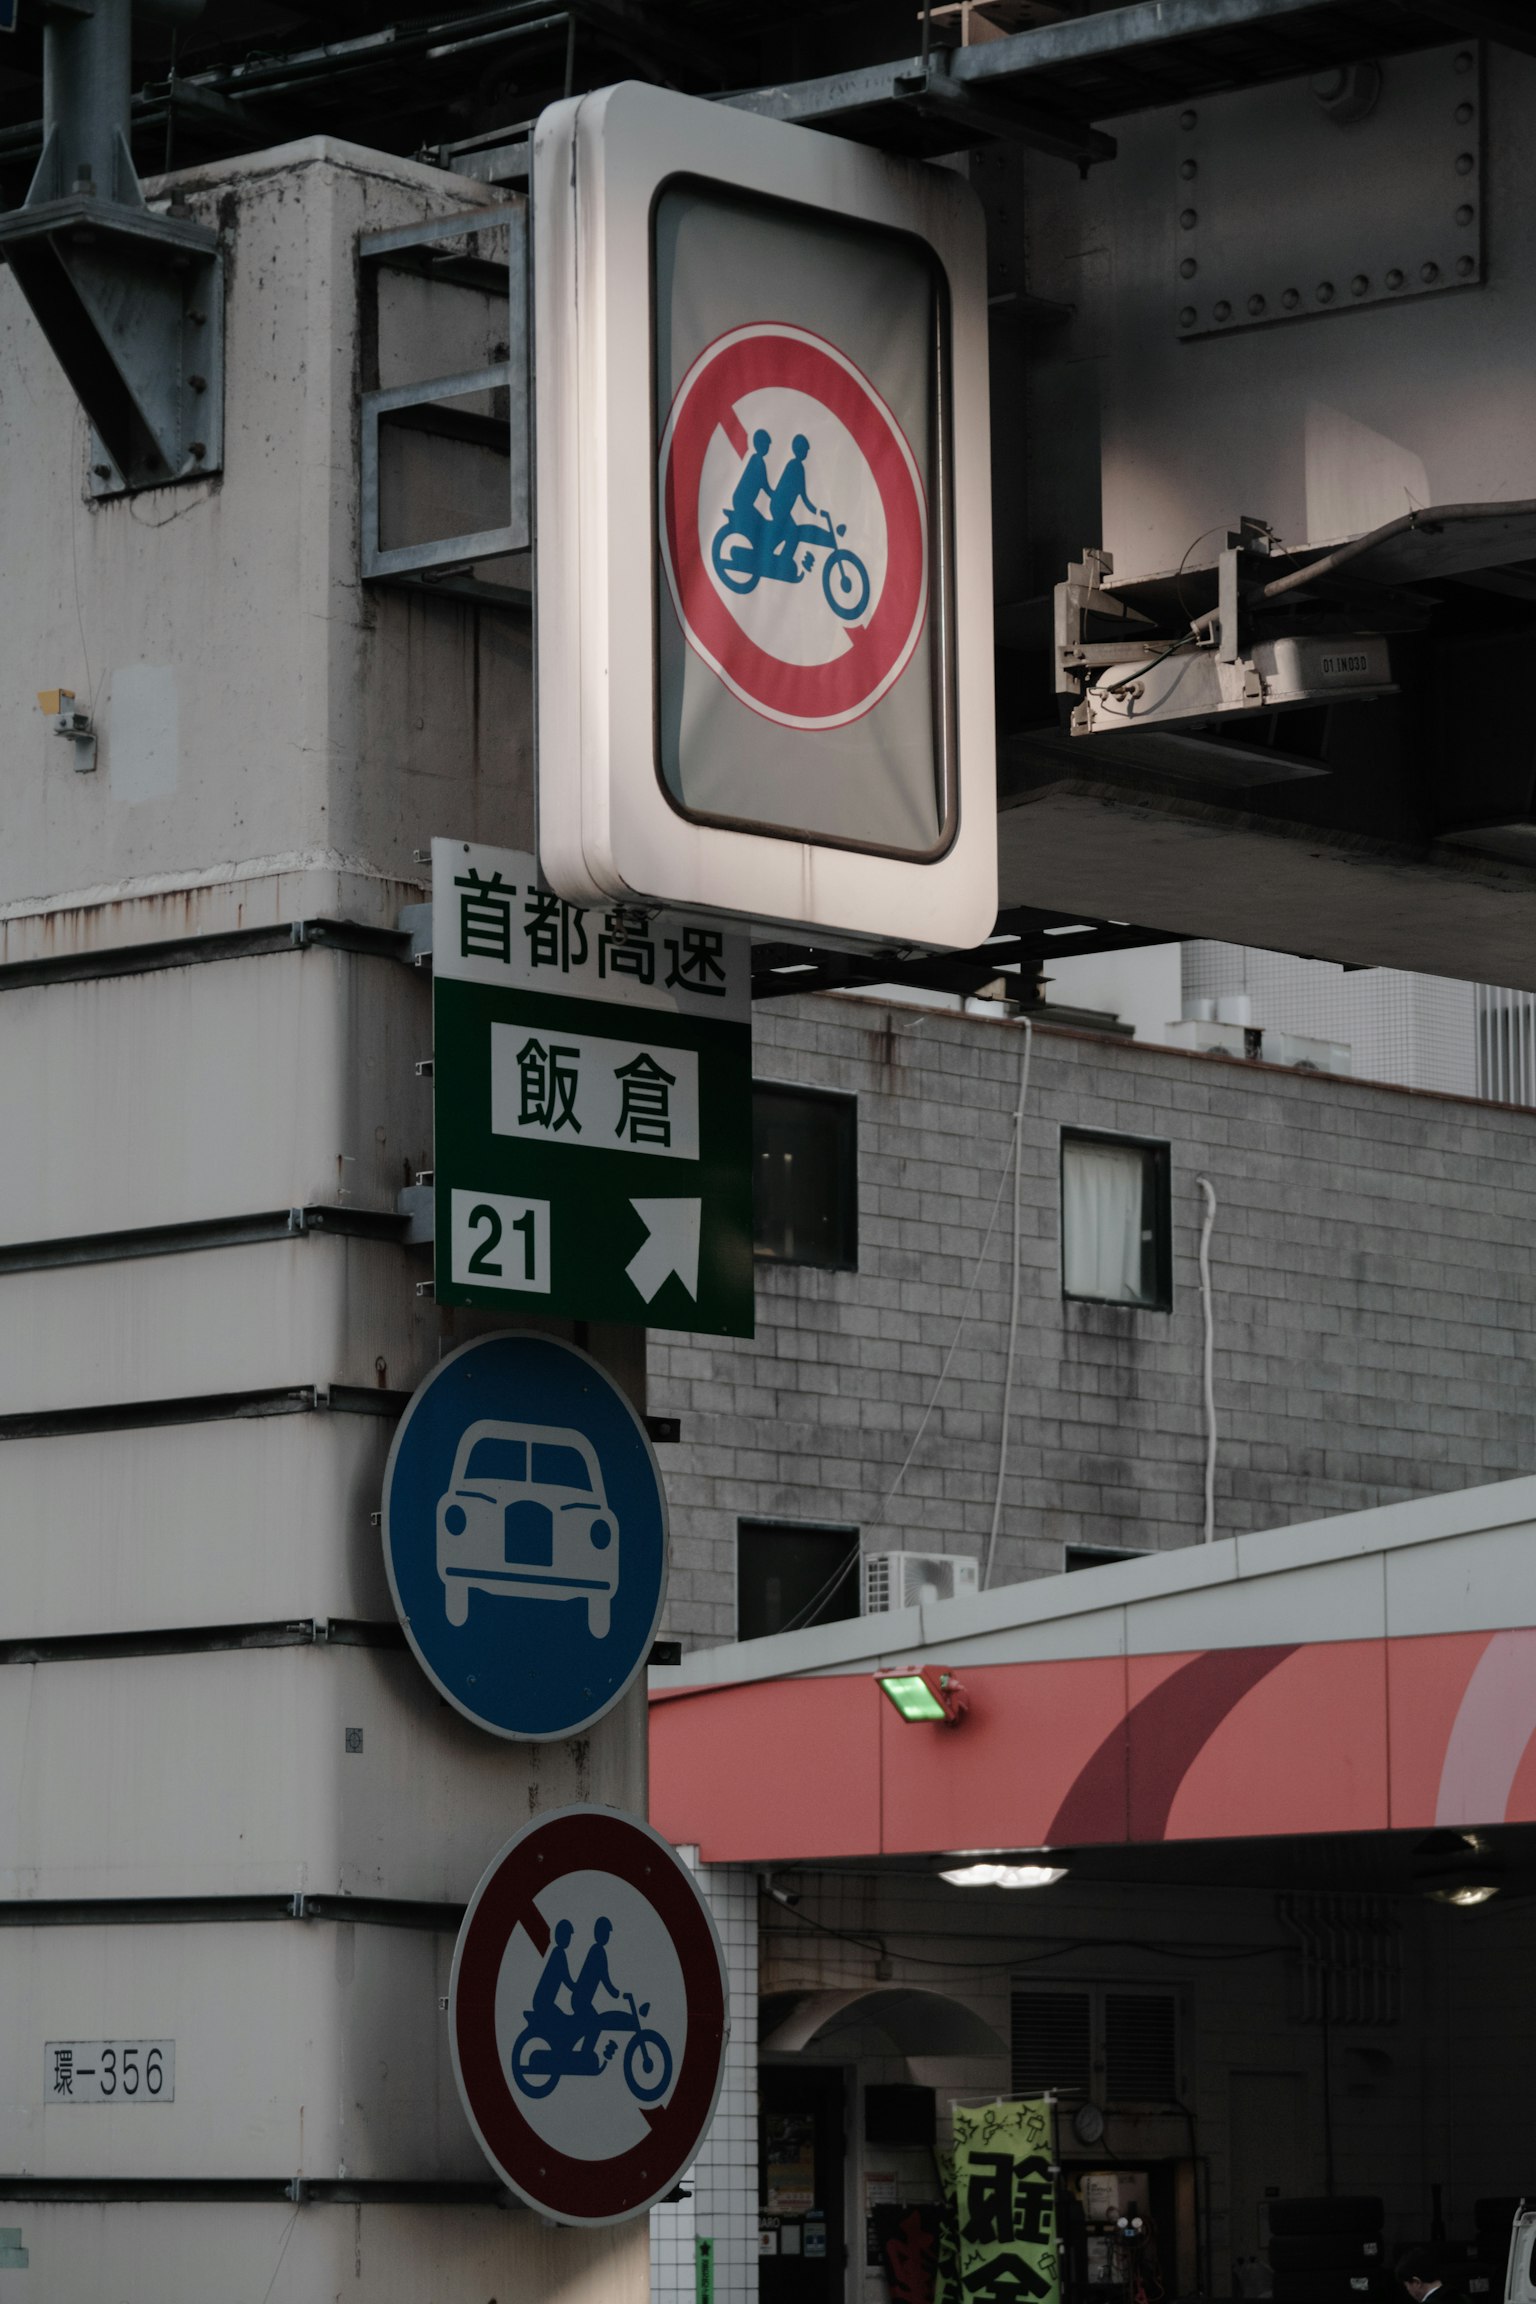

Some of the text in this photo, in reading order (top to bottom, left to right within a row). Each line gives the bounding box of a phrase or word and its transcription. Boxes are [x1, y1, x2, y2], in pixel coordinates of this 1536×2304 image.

[453, 867, 727, 996] 首都高速
[515, 1037, 677, 1148] 飯倉
[467, 1203, 536, 1281] 21
[53, 2047, 164, 2096] 環-356
